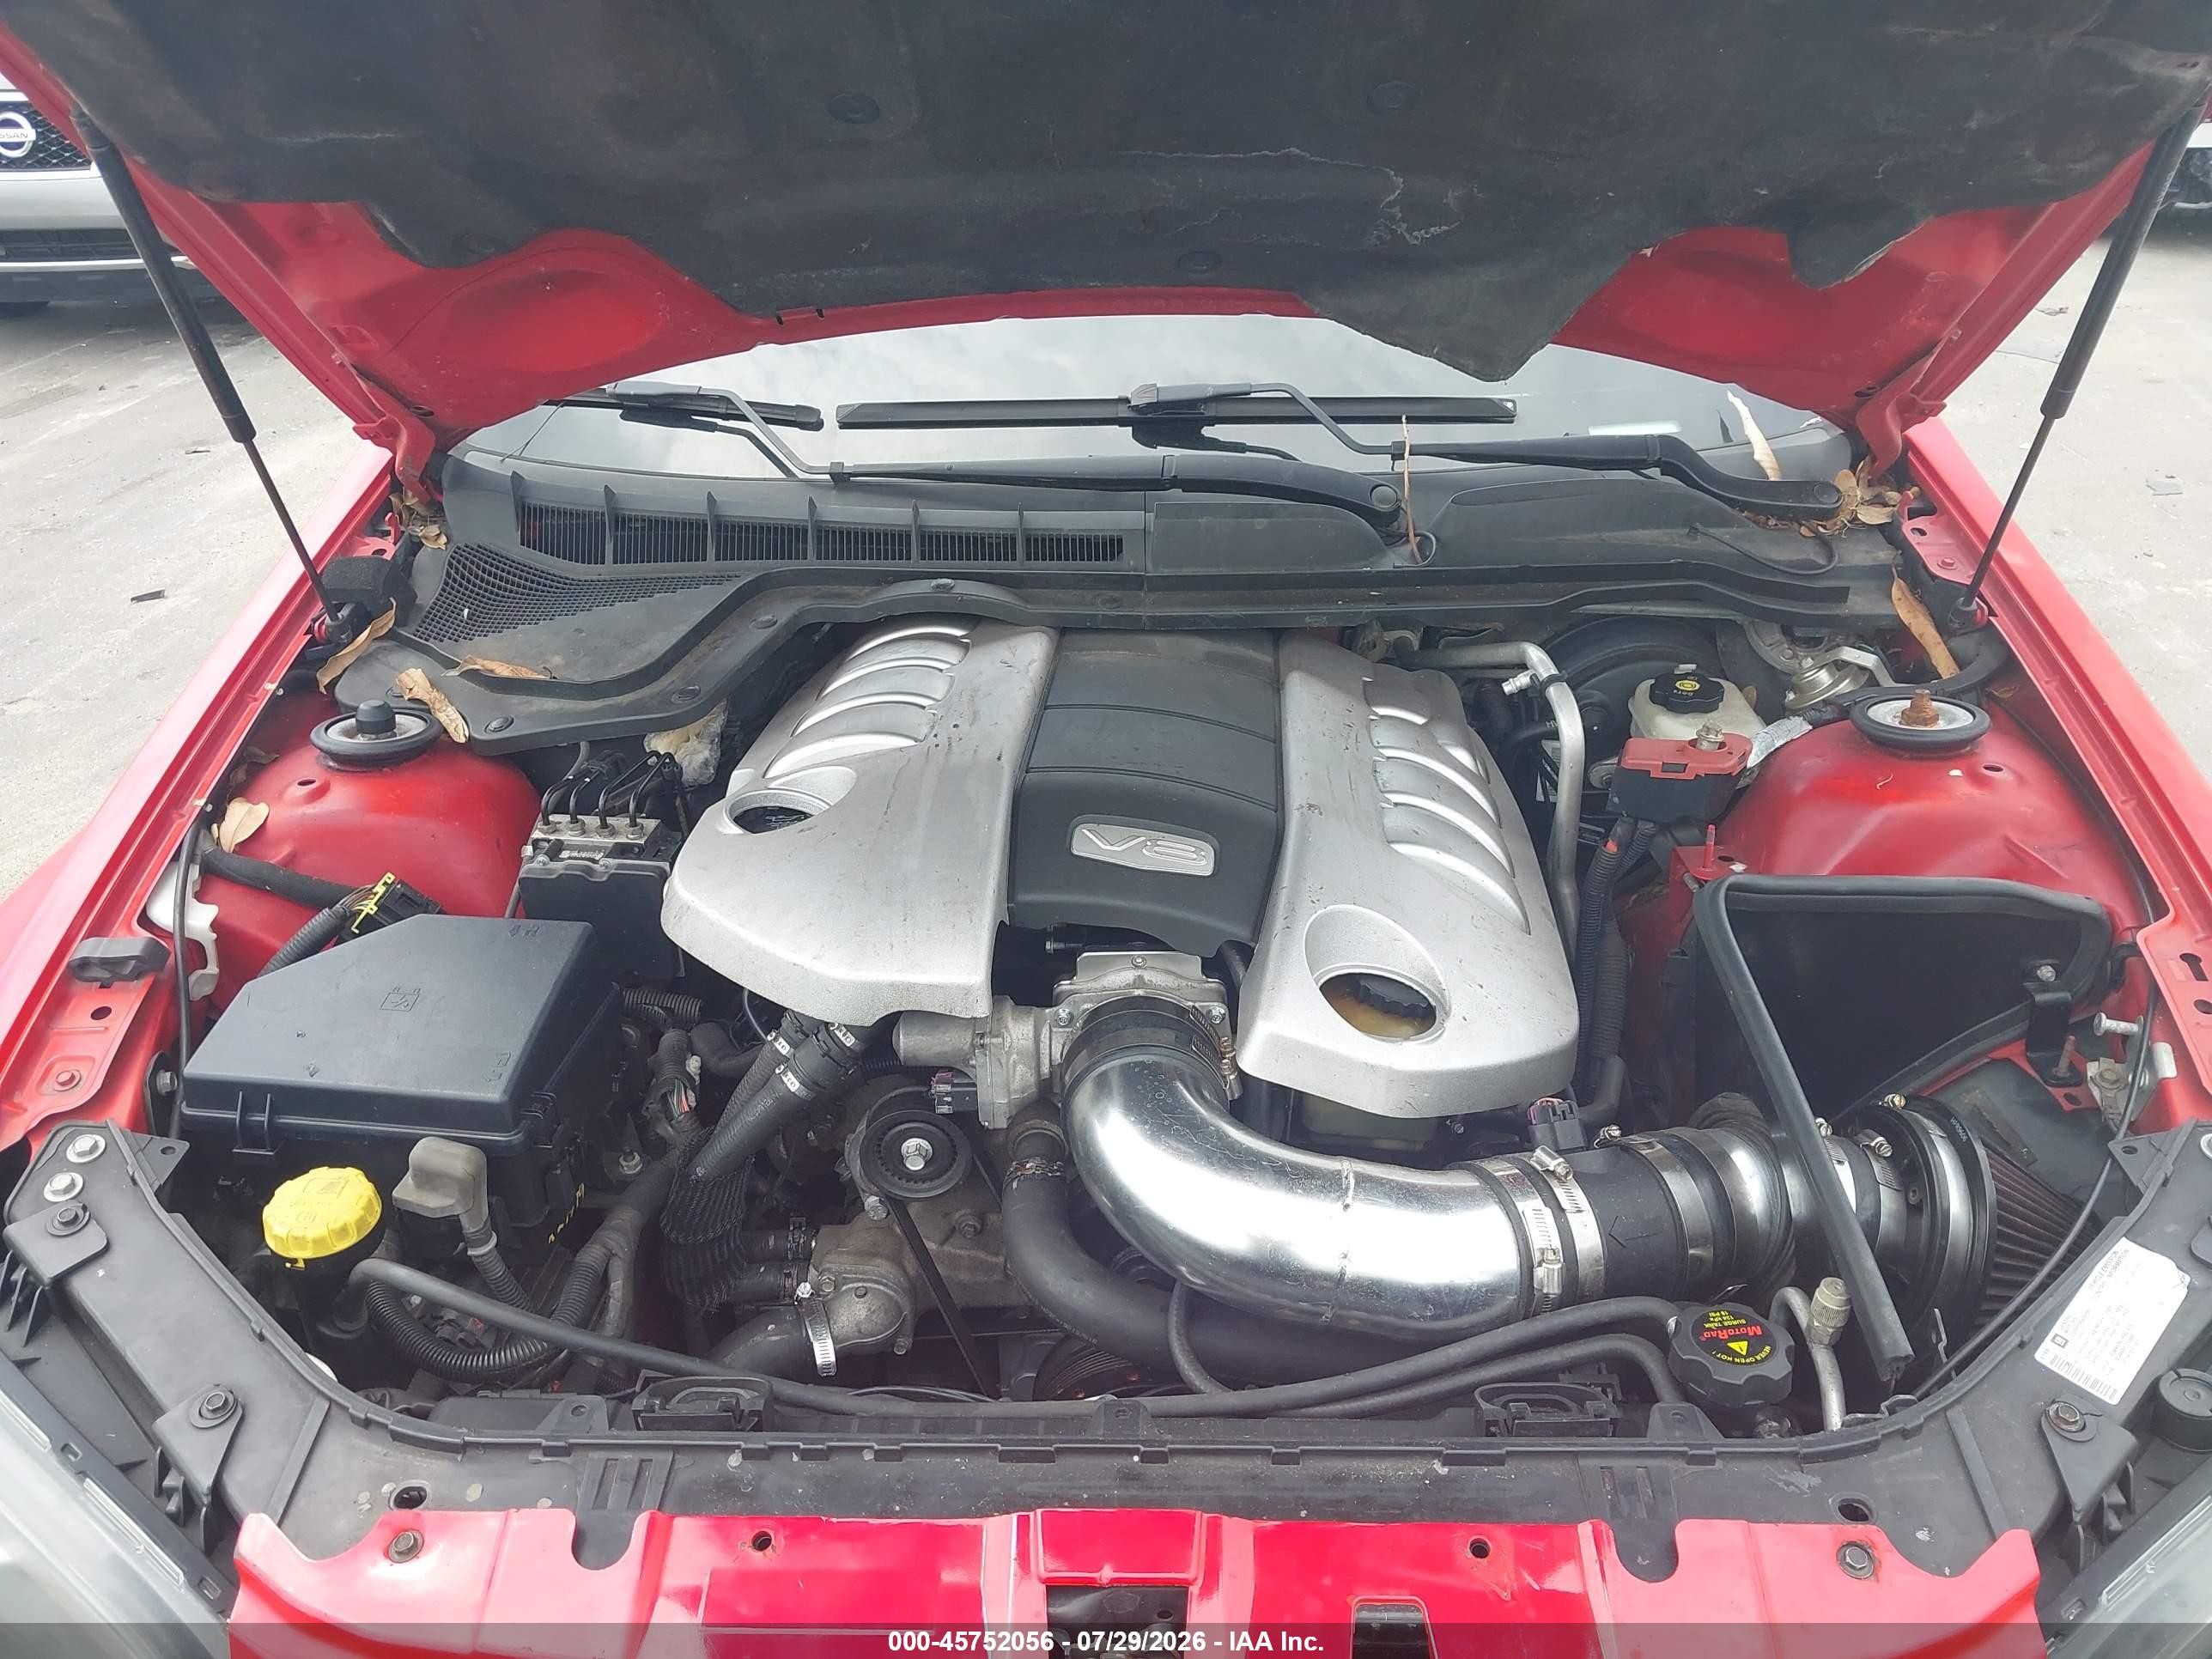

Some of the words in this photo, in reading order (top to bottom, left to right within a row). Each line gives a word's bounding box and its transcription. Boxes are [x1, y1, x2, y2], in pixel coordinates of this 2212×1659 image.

[1081, 829, 1207, 866] V8
[1716, 1352, 1733, 1362] HOT
[1753, 1345, 1772, 1361] NEVER
